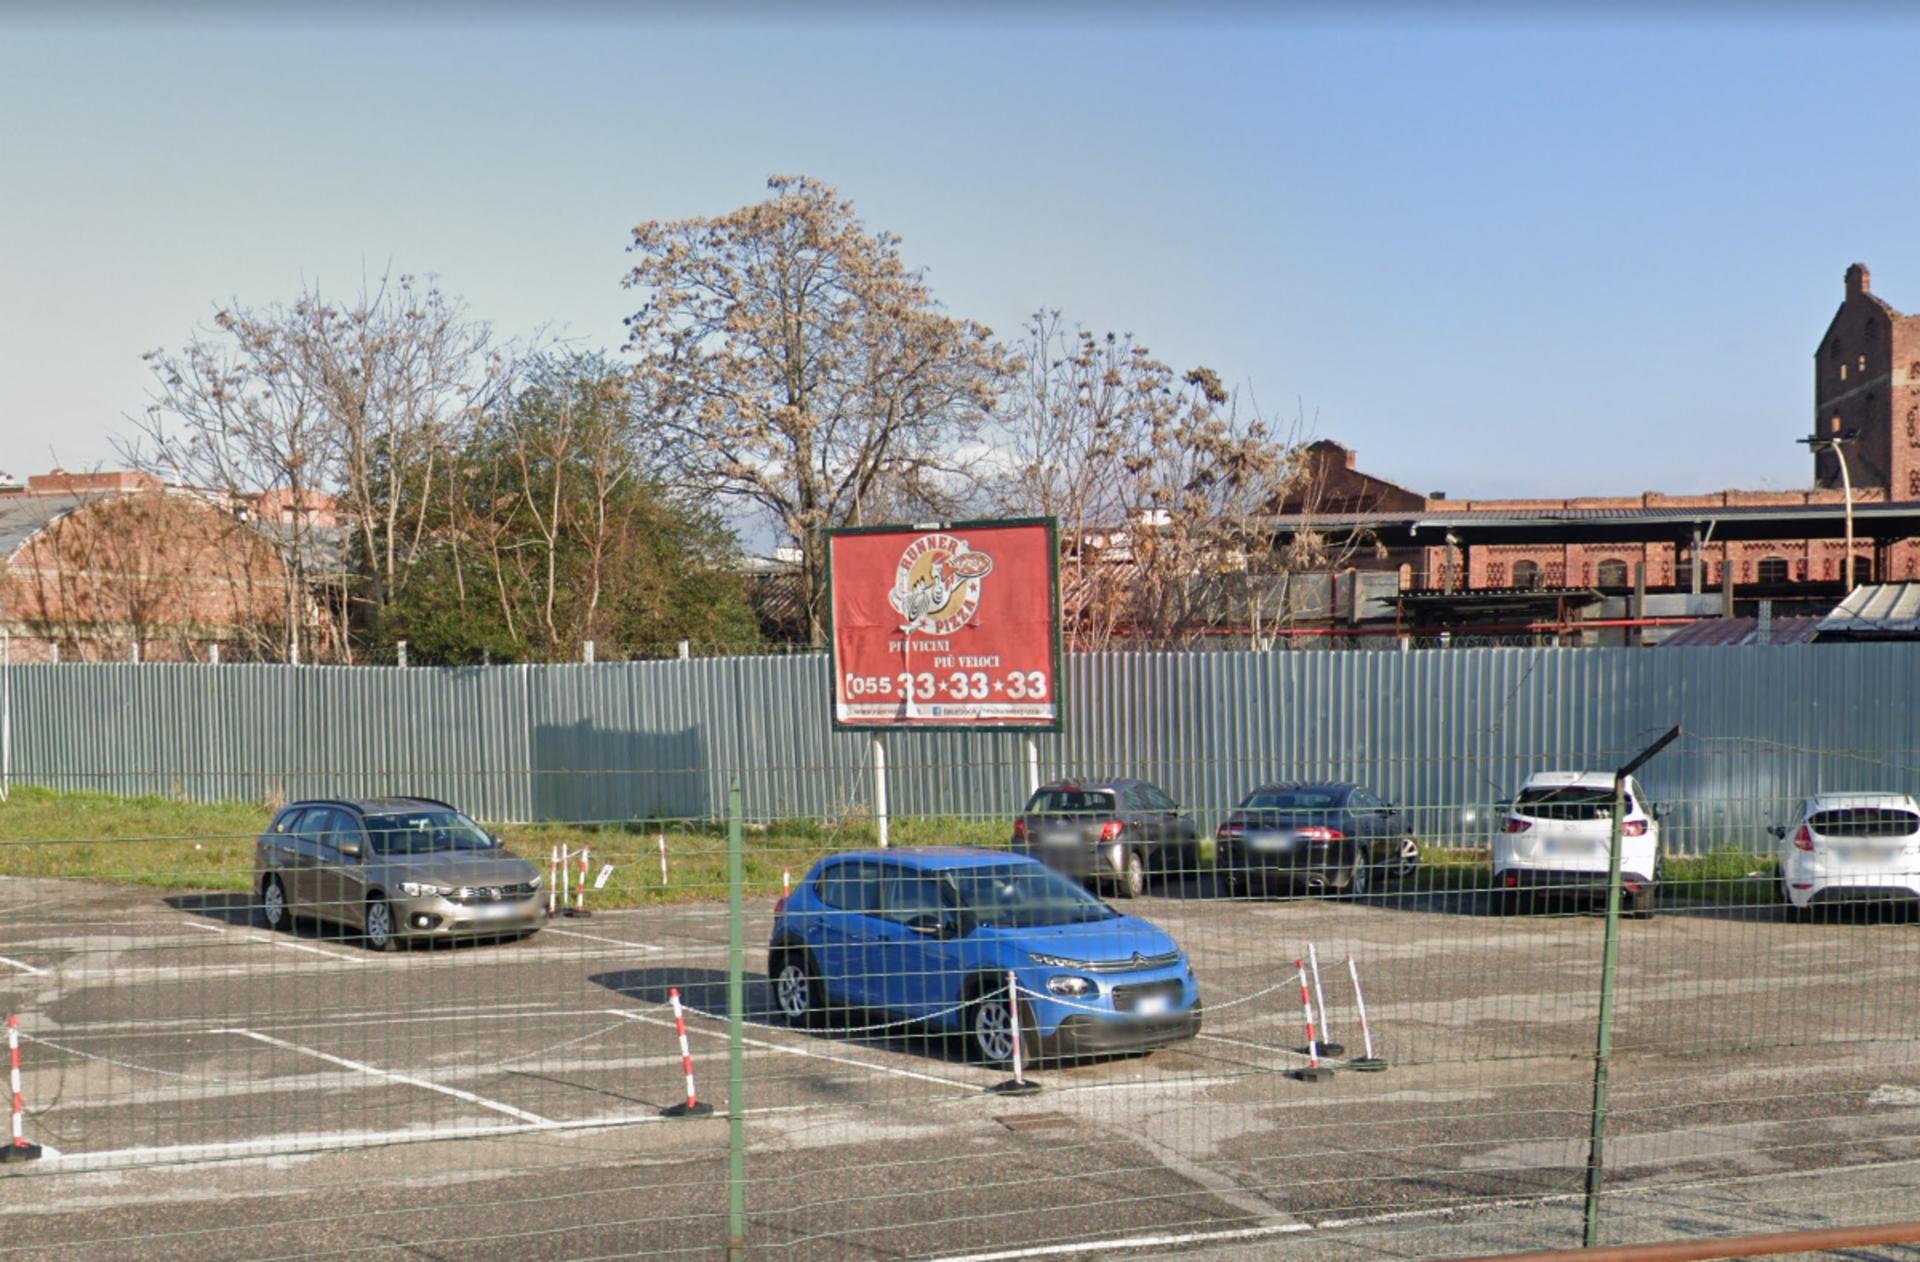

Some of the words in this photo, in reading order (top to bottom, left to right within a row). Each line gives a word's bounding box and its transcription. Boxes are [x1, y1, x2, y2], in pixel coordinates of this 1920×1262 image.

[901, 536, 959, 570] RUNNER
[935, 600, 975, 633] PIZZA
[912, 640, 951, 652] VICINI
[959, 656, 1000, 668] VELOCI
